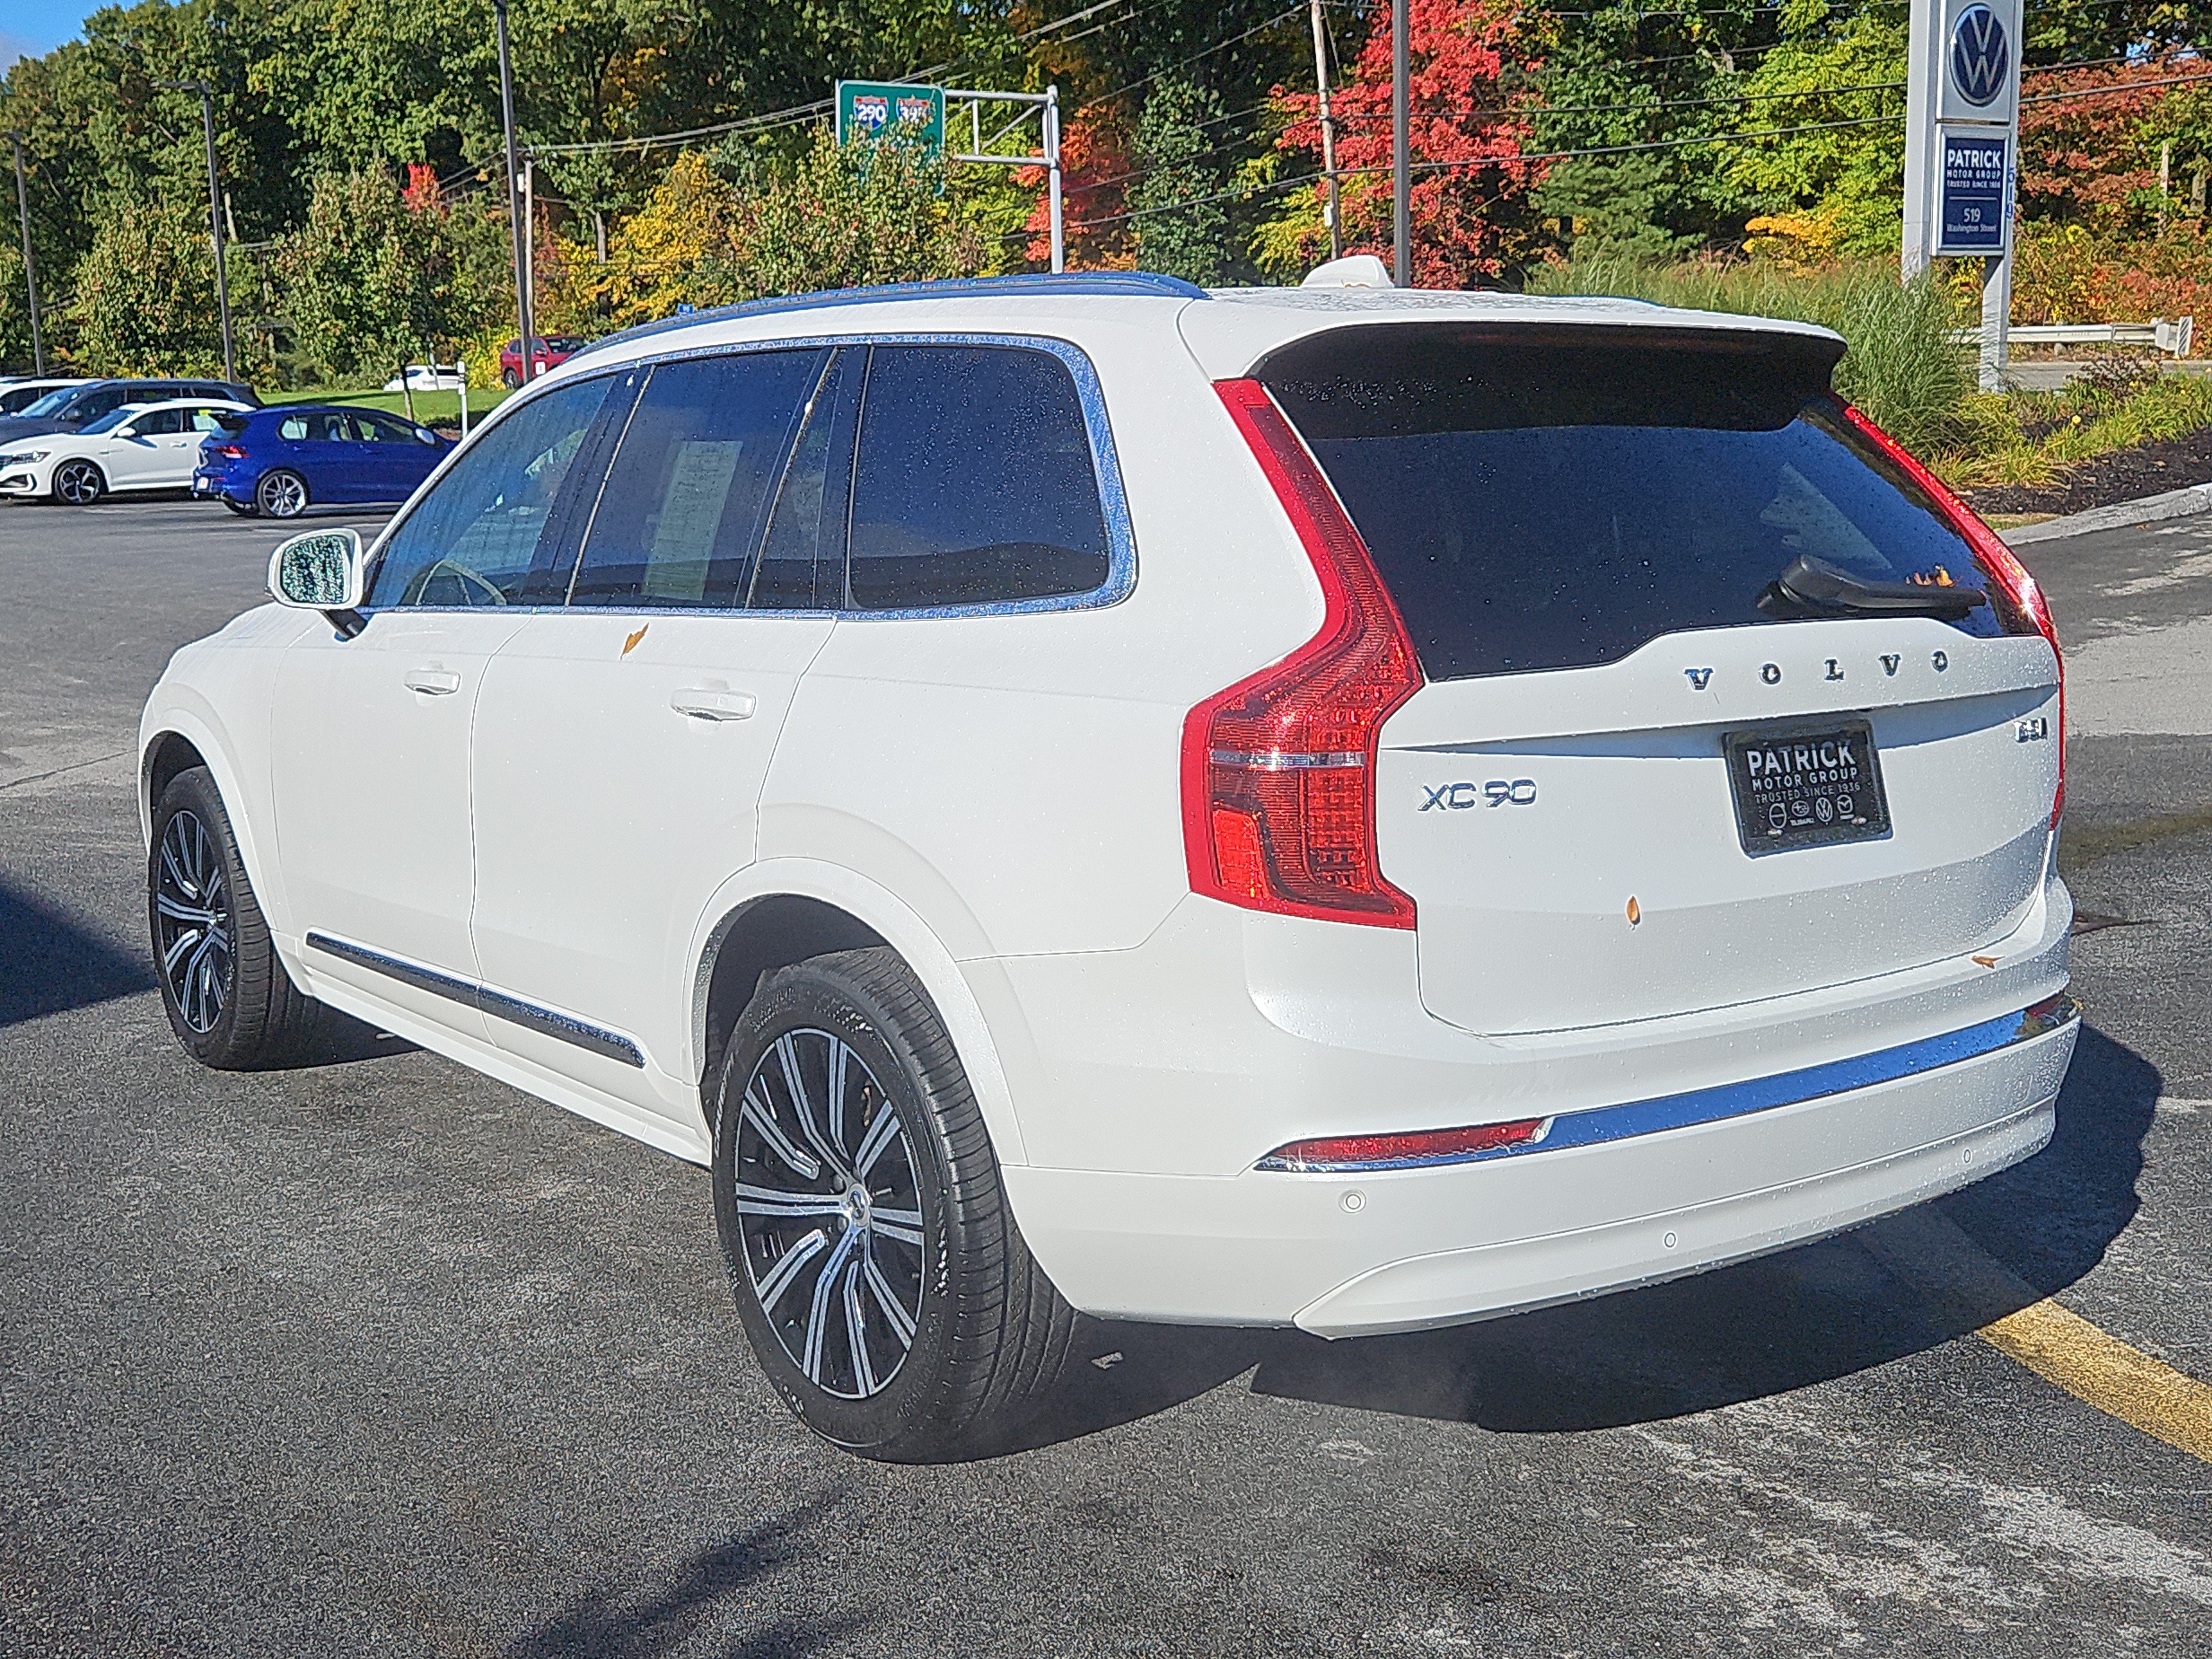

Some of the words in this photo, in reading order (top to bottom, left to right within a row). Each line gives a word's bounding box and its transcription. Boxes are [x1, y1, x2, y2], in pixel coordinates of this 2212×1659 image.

[858, 104, 886, 121] 290
[1947, 149, 2001, 169] PATRICK
[1947, 170, 1972, 179] MOTOR
[1976, 170, 2001, 179] GROUP
[1964, 207, 1980, 223] 519
[1684, 650, 1950, 691] VOLVO
[1746, 739, 1856, 777] PATRICK
[1752, 773, 1803, 792] MOTOR
[1809, 767, 1859, 783] GROUP
[1754, 789, 1801, 804] TRUSTED
[1802, 785, 1835, 798] SINCE
[1837, 782, 1861, 793] 1936
